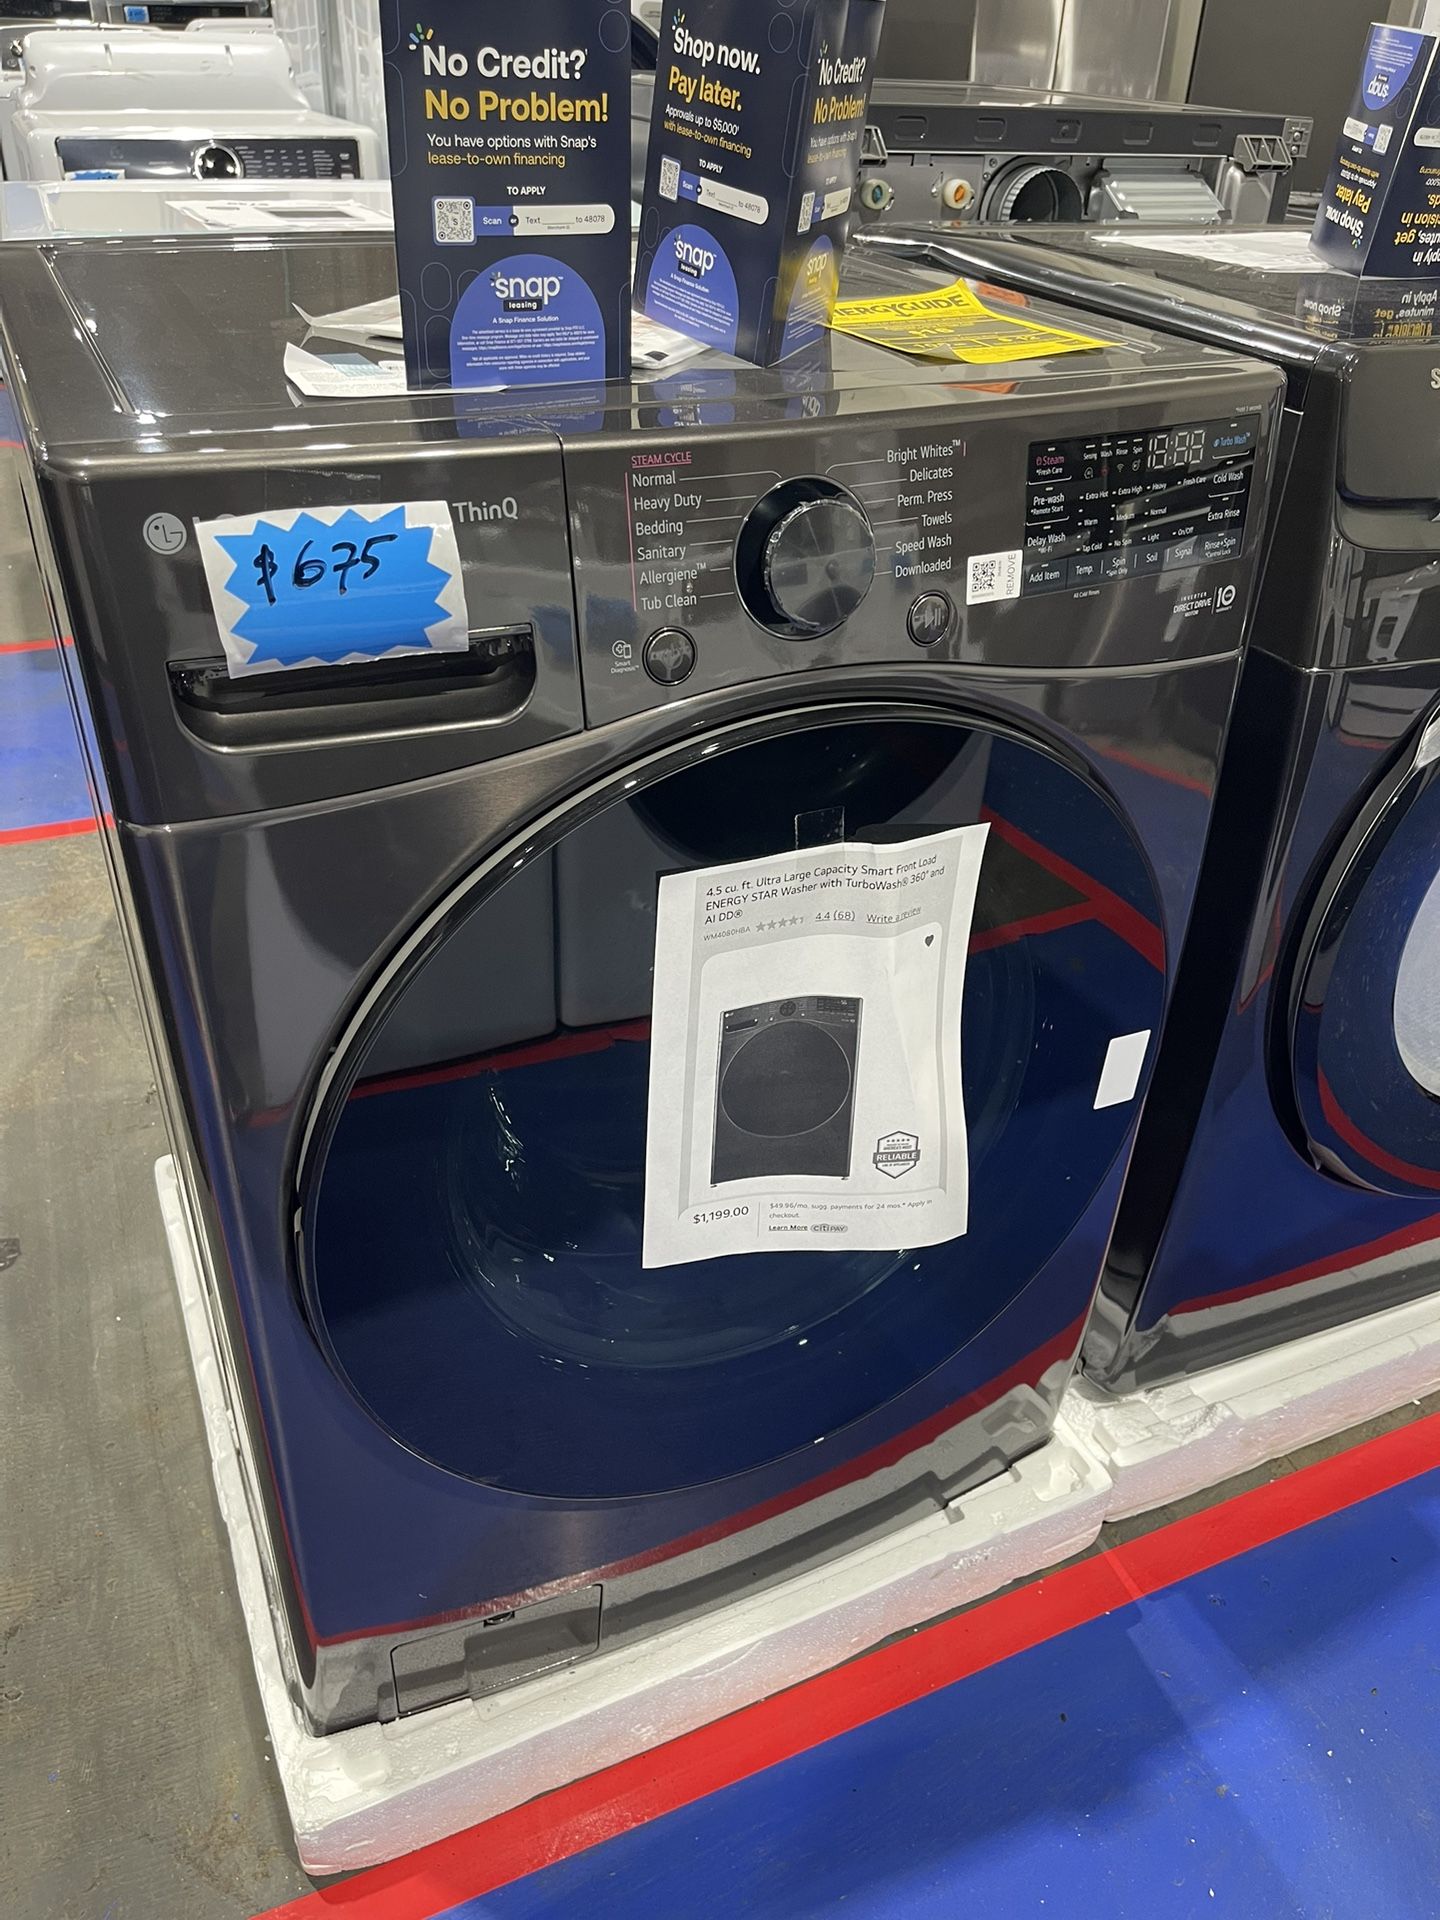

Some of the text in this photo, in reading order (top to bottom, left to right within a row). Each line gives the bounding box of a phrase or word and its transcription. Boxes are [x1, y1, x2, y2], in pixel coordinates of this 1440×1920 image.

[673, 27, 761, 75] Shop now.
[423, 45, 586, 80] No Credit?
[819, 56, 866, 86] No Credit?
[668, 66, 742, 112] Pay later.
[425, 89, 608, 122] No Problem!
[813, 93, 867, 124] No Problem!
[665, 104, 712, 127] Approvals up to
[427, 134, 597, 151] You have options with Snap's
[663, 119, 752, 159] with lease-to-own financing
[428, 152, 565, 168] lease-to-own financing
[698, 158, 723, 174] TO APPLY
[507, 186, 546, 195] TO APPLY
[1335, 184, 1371, 214] Pay later.
[482, 217, 502, 225] Scan
[525, 216, 541, 224] Text
[584, 215, 605, 223] 48078
[1340, 210, 1364, 238] Shop
[1401, 212, 1413, 228] in
[1394, 230, 1416, 246] get
[675, 240, 714, 276] snap
[1413, 251, 1423, 266] in
[495, 276, 561, 305] snap
[508, 301, 538, 309] leasing
[498, 317, 513, 325] Snap
[631, 451, 692, 466] STEAM CYCLE
[887, 448, 917, 465] Bright
[1116, 448, 1128, 456] Rinse
[1132, 446, 1143, 454] Spin
[1043, 455, 1065, 465] Steam
[632, 471, 676, 487] Normal
[909, 467, 953, 482] Delicates
[1183, 478, 1195, 486] Fresh
[1213, 471, 1244, 484] Cold Wash
[1118, 485, 1143, 496] Extra High
[1152, 483, 1167, 491] Heavy
[634, 494, 701, 511] Heavy Duty
[897, 490, 953, 507] Perm. Press
[1033, 493, 1065, 506] Pre-wash
[1085, 490, 1109, 500] Extra Hot
[452, 497, 518, 523] ThinQ
[1051, 505, 1064, 513] Start
[1150, 507, 1167, 515] Normal
[1207, 509, 1240, 521] Extra Rinse
[921, 511, 953, 527] Towels
[1084, 518, 1098, 526] Warm
[636, 520, 683, 536] Bedding
[1178, 526, 1194, 536] On/Off
[1027, 532, 1066, 547] Delay Wash
[1121, 537, 1132, 546] Spin
[1147, 533, 1160, 542] Light
[895, 535, 952, 556] Speed Wash
[1082, 542, 1103, 552] Tap Cold
[1174, 546, 1193, 559] Signal
[637, 546, 686, 561] Sanitary
[1146, 552, 1158, 563] Soil
[895, 557, 952, 578] Downloaded
[1112, 557, 1126, 568] Spin
[1006, 553, 1016, 595] REMOVE
[1029, 571, 1060, 583] Add Item
[640, 593, 697, 610] Tub Clean
[1181, 591, 1207, 601] INVERTER
[1217, 585, 1236, 608] 10
[1173, 602, 1194, 613] DIRECT
[1194, 597, 1212, 610] DRIVE
[1184, 609, 1199, 617] MOTOR
[706, 855, 937, 897] 4.5 cu. ft. Ultra Large Capacity Smart Front Load
[705, 894, 748, 911] ENERGY
[751, 888, 778, 902] STAR
[781, 883, 817, 897] Washer
[820, 878, 842, 889] with
[930, 865, 945, 877] and
[705, 914, 717, 925] AI
[815, 911, 831, 922] 4.4
[833, 909, 856, 922] (68)
[866, 912, 893, 924] Write
[901, 906, 922, 920] review
[876, 1152, 917, 1161] RELIABLE
[830, 1203, 863, 1211] payments
[907, 1200, 925, 1208] Apply
[693, 1206, 749, 1224] $1,199.00
